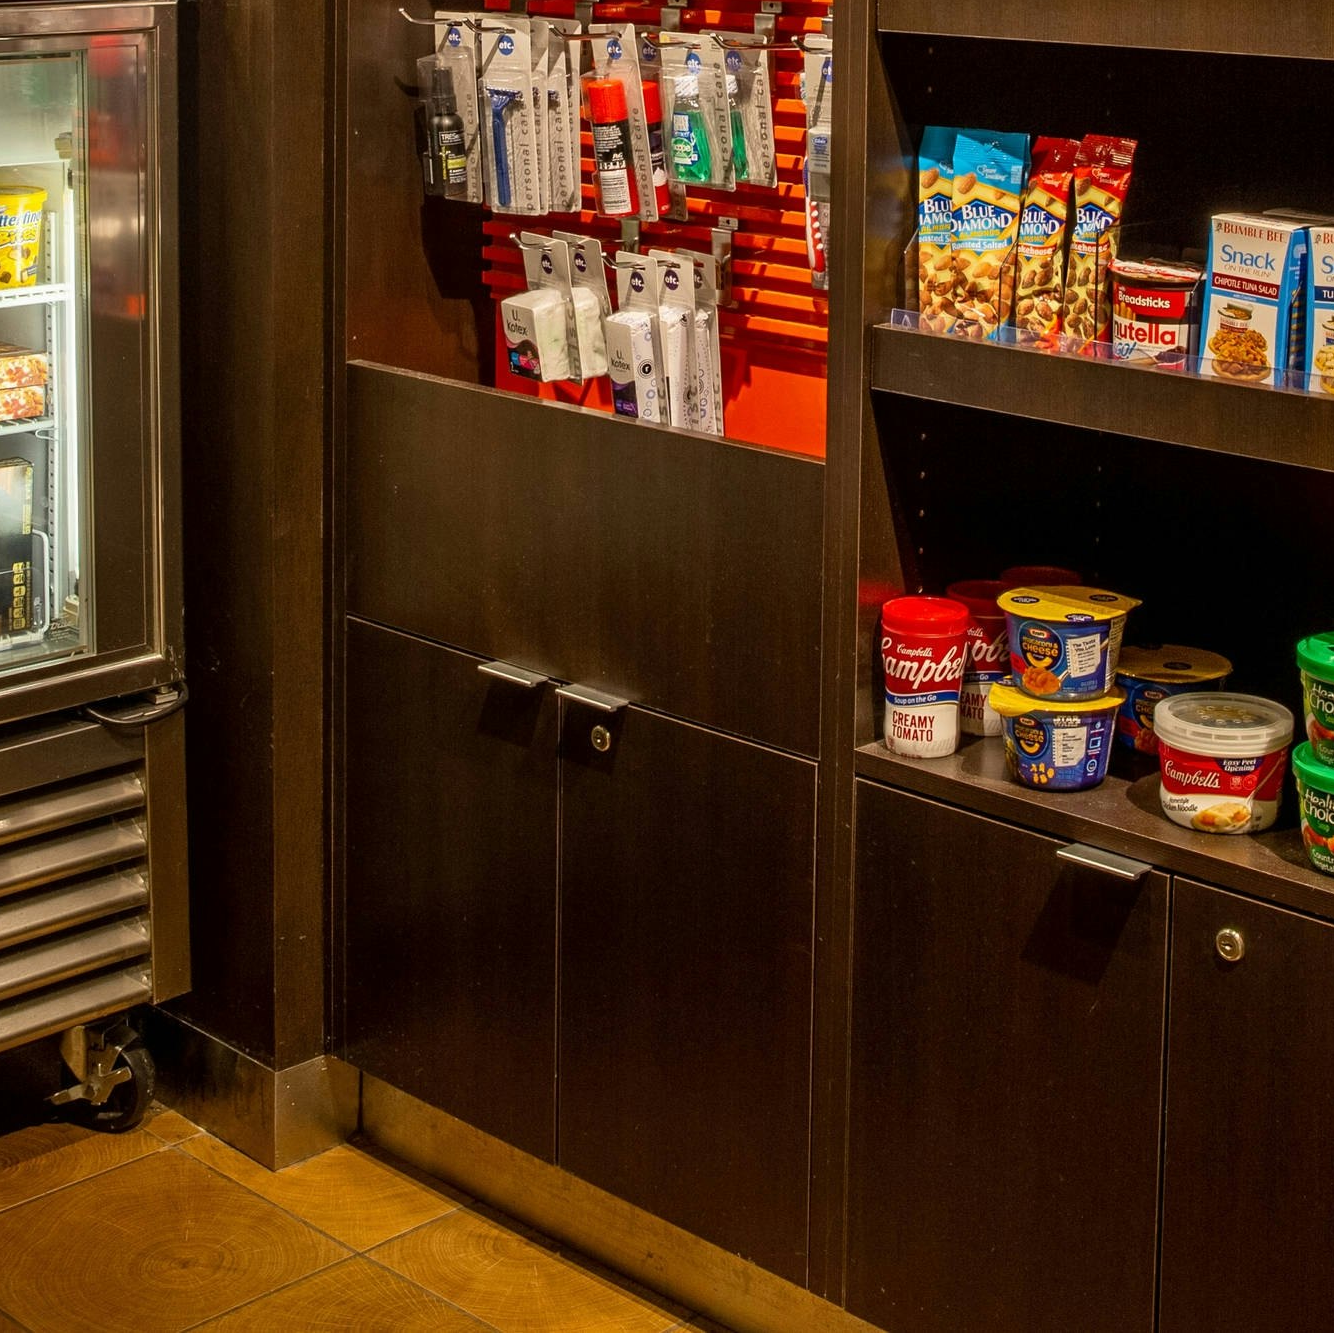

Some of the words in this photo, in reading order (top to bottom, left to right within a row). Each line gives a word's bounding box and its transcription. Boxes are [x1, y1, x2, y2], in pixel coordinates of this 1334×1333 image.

[962, 204, 995, 220] BLUE
[1223, 222, 1265, 242] BUMBLE
[1266, 229, 1285, 243] BEE
[981, 239, 1007, 250] Salted
[1221, 243, 1276, 271] Snack
[1214, 275, 1241, 290] CHIPOTLE
[1241, 281, 1258, 292] TUNA
[1258, 284, 1278, 296] SALAD
[1118, 291, 1171, 309] Breadsticks
[506, 319, 528, 336] kotex
[892, 710, 934, 728] CREAMY
[892, 725, 933, 742] TOMATO
[1164, 759, 1221, 789] Campbell's
